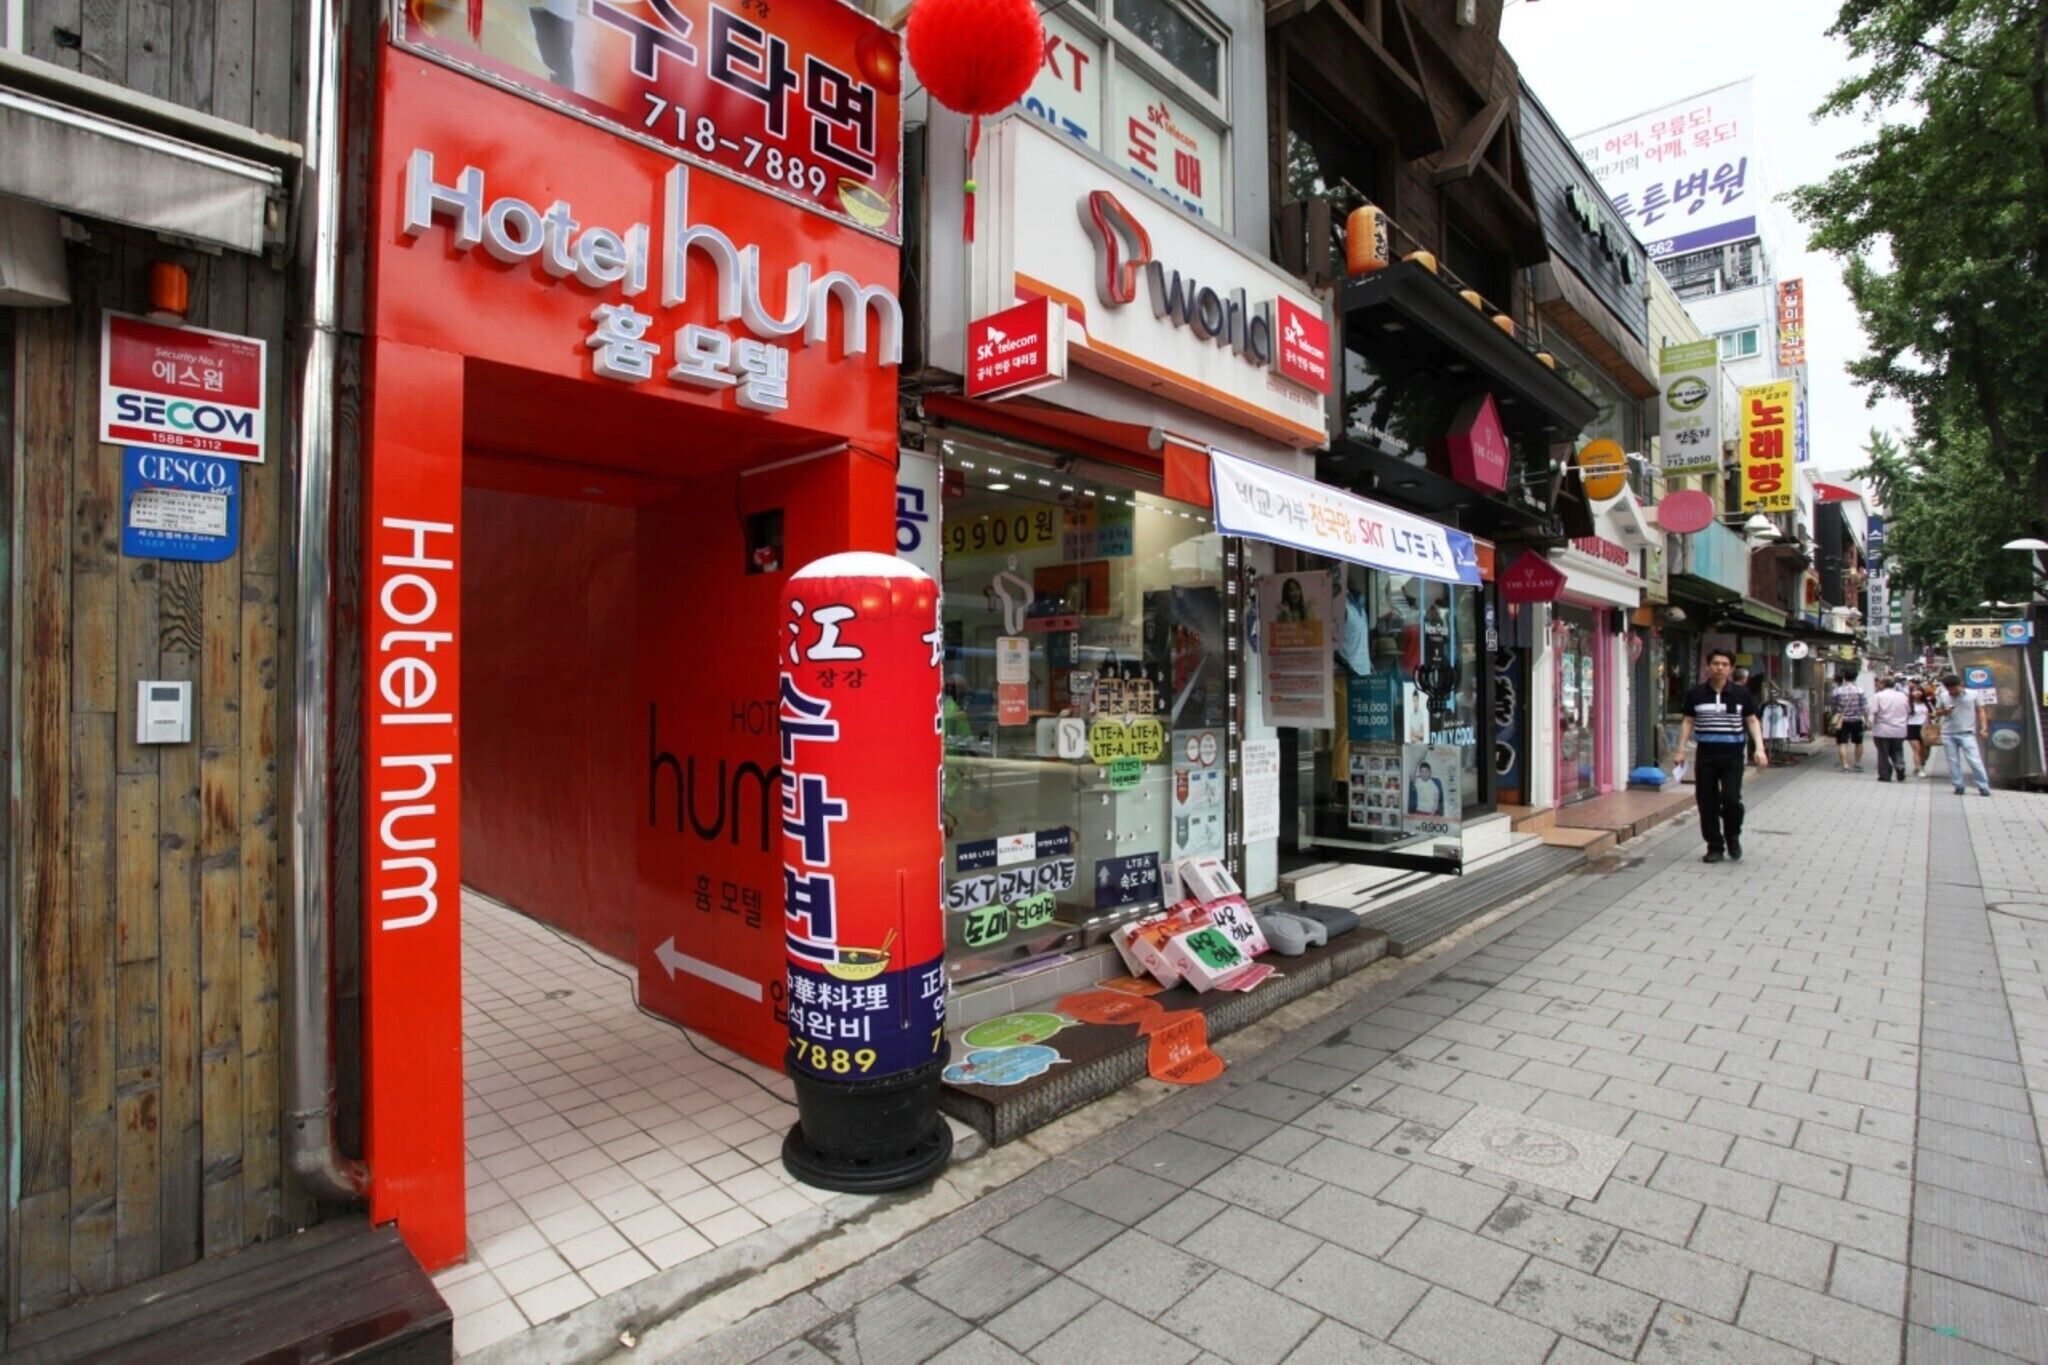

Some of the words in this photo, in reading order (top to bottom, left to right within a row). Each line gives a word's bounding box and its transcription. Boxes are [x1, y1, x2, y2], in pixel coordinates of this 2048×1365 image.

[588, 0, 877, 180] 수타면
[1148, 105, 1164, 128] SK
[1165, 123, 1198, 151] telecom
[1650, 106, 1712, 141] 무릎도!
[642, 91, 828, 197] 718-7889
[1128, 115, 1202, 198] 도매
[1593, 155, 1639, 181] 만기의
[1645, 139, 1686, 163] 어깨,
[1693, 121, 1738, 149] 목도!
[404, 148, 649, 297] Hotel
[661, 163, 903, 368] hum
[1147, 260, 1271, 367] world
[155, 346, 197, 364] Security
[977, 342, 994, 361] SK
[998, 333, 1037, 354] telecom
[1284, 326, 1297, 347] SK
[152, 360, 224, 392] 에스원
[668, 323, 789, 413] 모텔
[117, 394, 253, 439] SECOM
[152, 432, 222, 451] 1588-3112
[1667, 458, 1684, 467] 712
[1688, 455, 1712, 465] 9050
[1748, 397, 1785, 495] 노래방
[138, 454, 226, 486] CESCO
[1357, 517, 1386, 548] SKT
[1390, 527, 1427, 559] LTE
[380, 517, 454, 725] Hotel
[787, 600, 865, 665] 江
[816, 668, 867, 689] 장강
[731, 701, 782, 736] HOT
[1093, 726, 1125, 741] LTE-A
[1131, 725, 1160, 740] LTE-A
[1093, 742, 1125, 758] LTE-A
[1131, 741, 1160, 756] LTE-A
[649, 701, 783, 853] hum
[380, 754, 453, 931] hum
[948, 879, 996, 908] SKT
[1000, 869, 1036, 903] 공식
[1120, 872, 1139, 889] 속도
[720, 880, 762, 930] 모텔
[966, 910, 1009, 943] 도매
